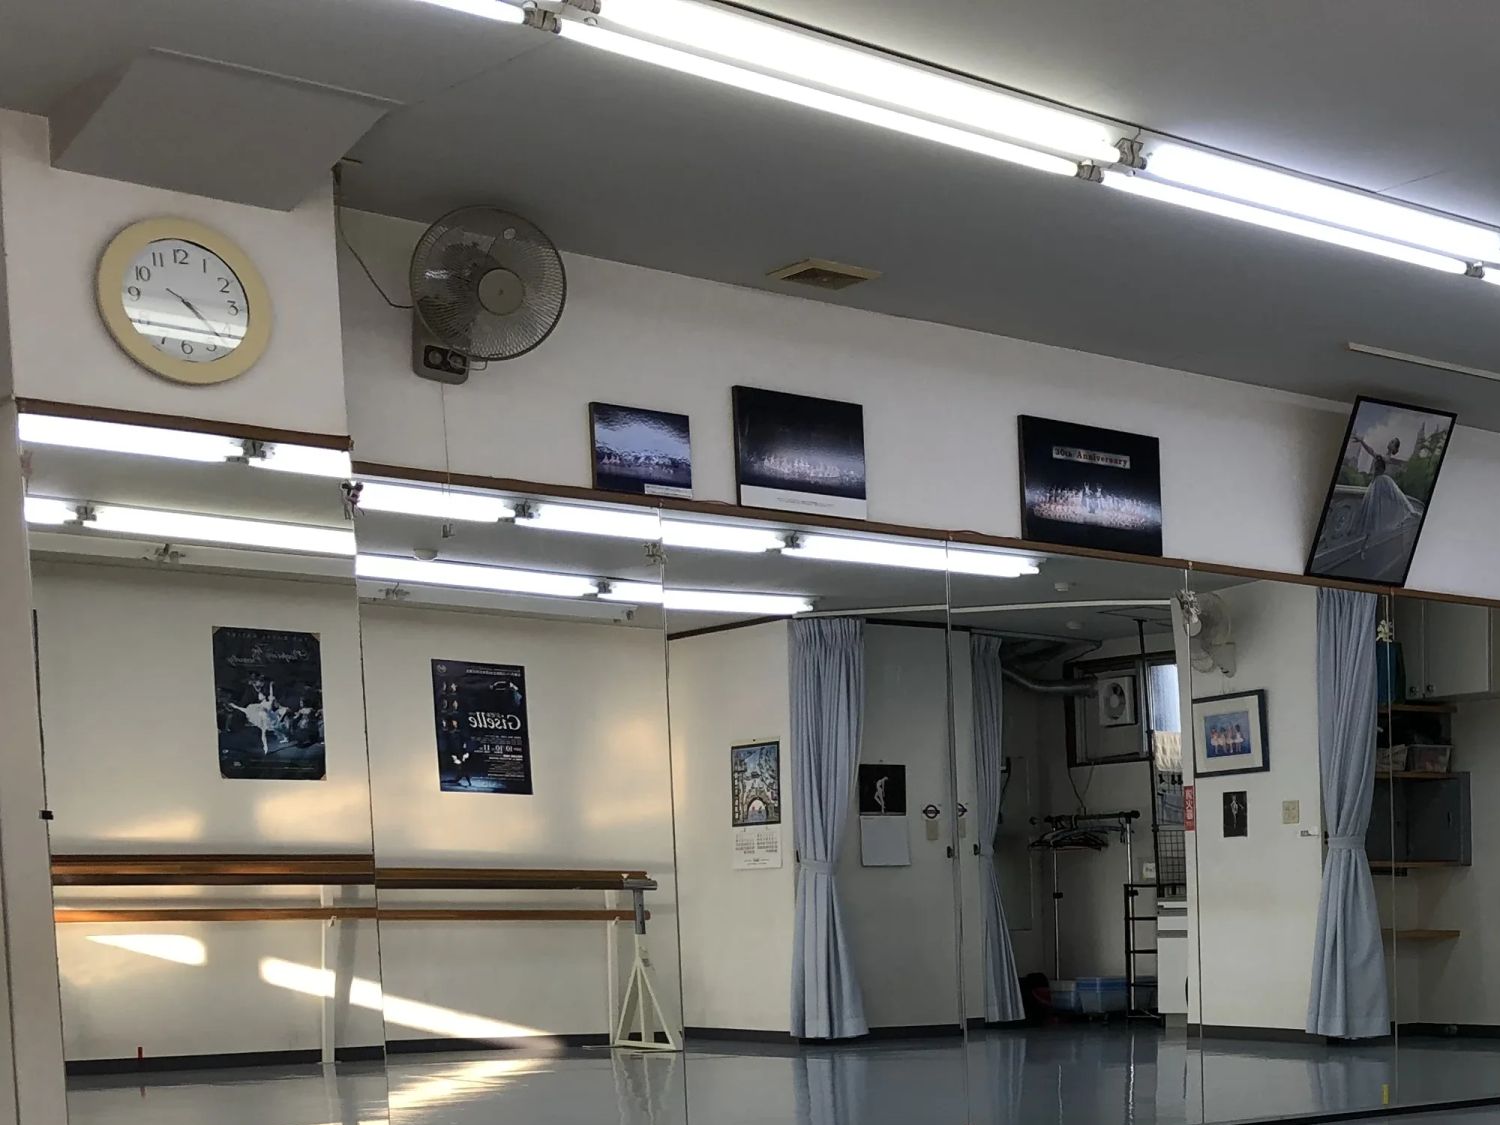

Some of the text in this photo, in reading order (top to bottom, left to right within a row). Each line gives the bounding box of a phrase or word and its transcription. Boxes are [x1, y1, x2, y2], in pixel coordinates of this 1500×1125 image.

[151, 252, 164, 268] 11
[172, 248, 189, 265] 12
[135, 265, 151, 282] 10
[202, 258, 207, 274] 1
[127, 286, 141, 301] 9
[217, 277, 230, 294] 2
[227, 300, 239, 316] 3
[180, 340, 193, 355] 6
[1076, 450, 1128, 467] Anniversary
